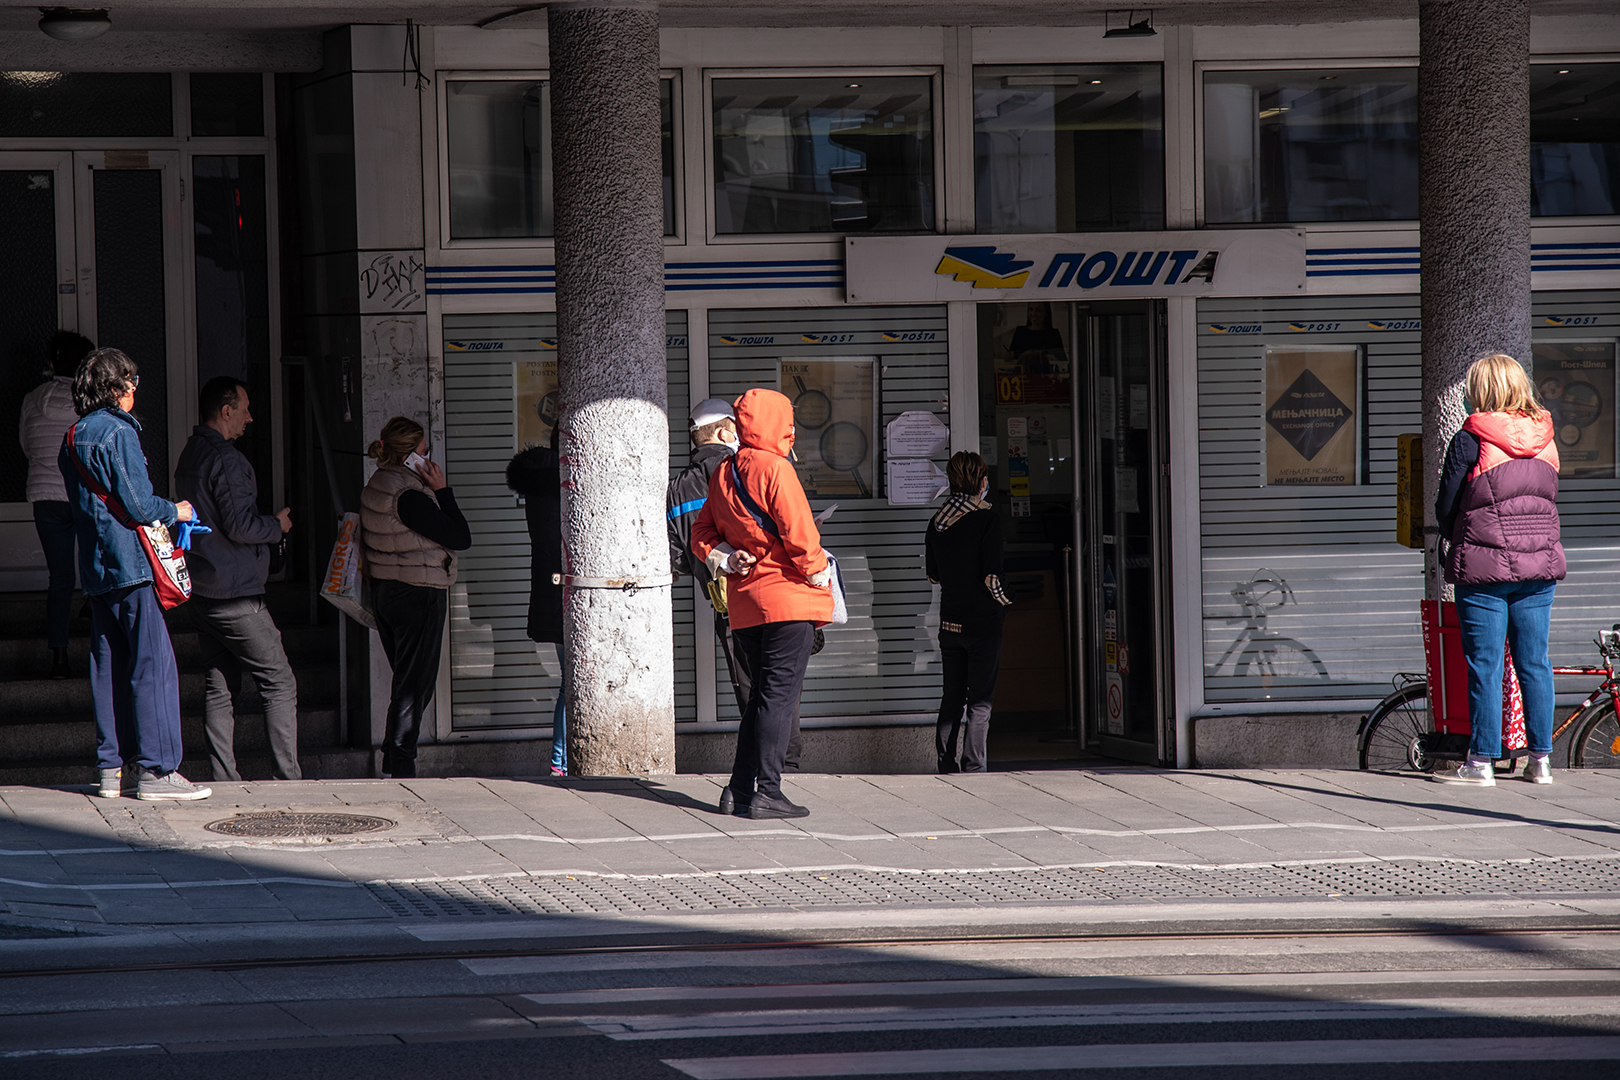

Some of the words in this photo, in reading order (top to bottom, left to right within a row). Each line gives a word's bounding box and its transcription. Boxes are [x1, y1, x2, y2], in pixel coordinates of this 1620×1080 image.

[1038, 250, 1219, 289] ПОШТА
[1386, 319, 1420, 329] POŠTA
[1565, 316, 1598, 325] POST
[1227, 324, 1262, 333] ПОШТА
[1308, 322, 1341, 331] POST
[739, 336, 774, 345] ПОШТА
[820, 334, 855, 343] POST
[901, 331, 936, 341] POŠTA
[666, 336, 686, 346] ŠTA
[467, 342, 504, 350] ПОШТА
[1560, 361, 1607, 369] Пост-Шпед
[1001, 377, 1022, 401] 03
[1271, 407, 1345, 419] МЕЊАЧНИЦА
[1321, 475, 1345, 483] МЕСТО
[327, 520, 354, 593] MIGROS
